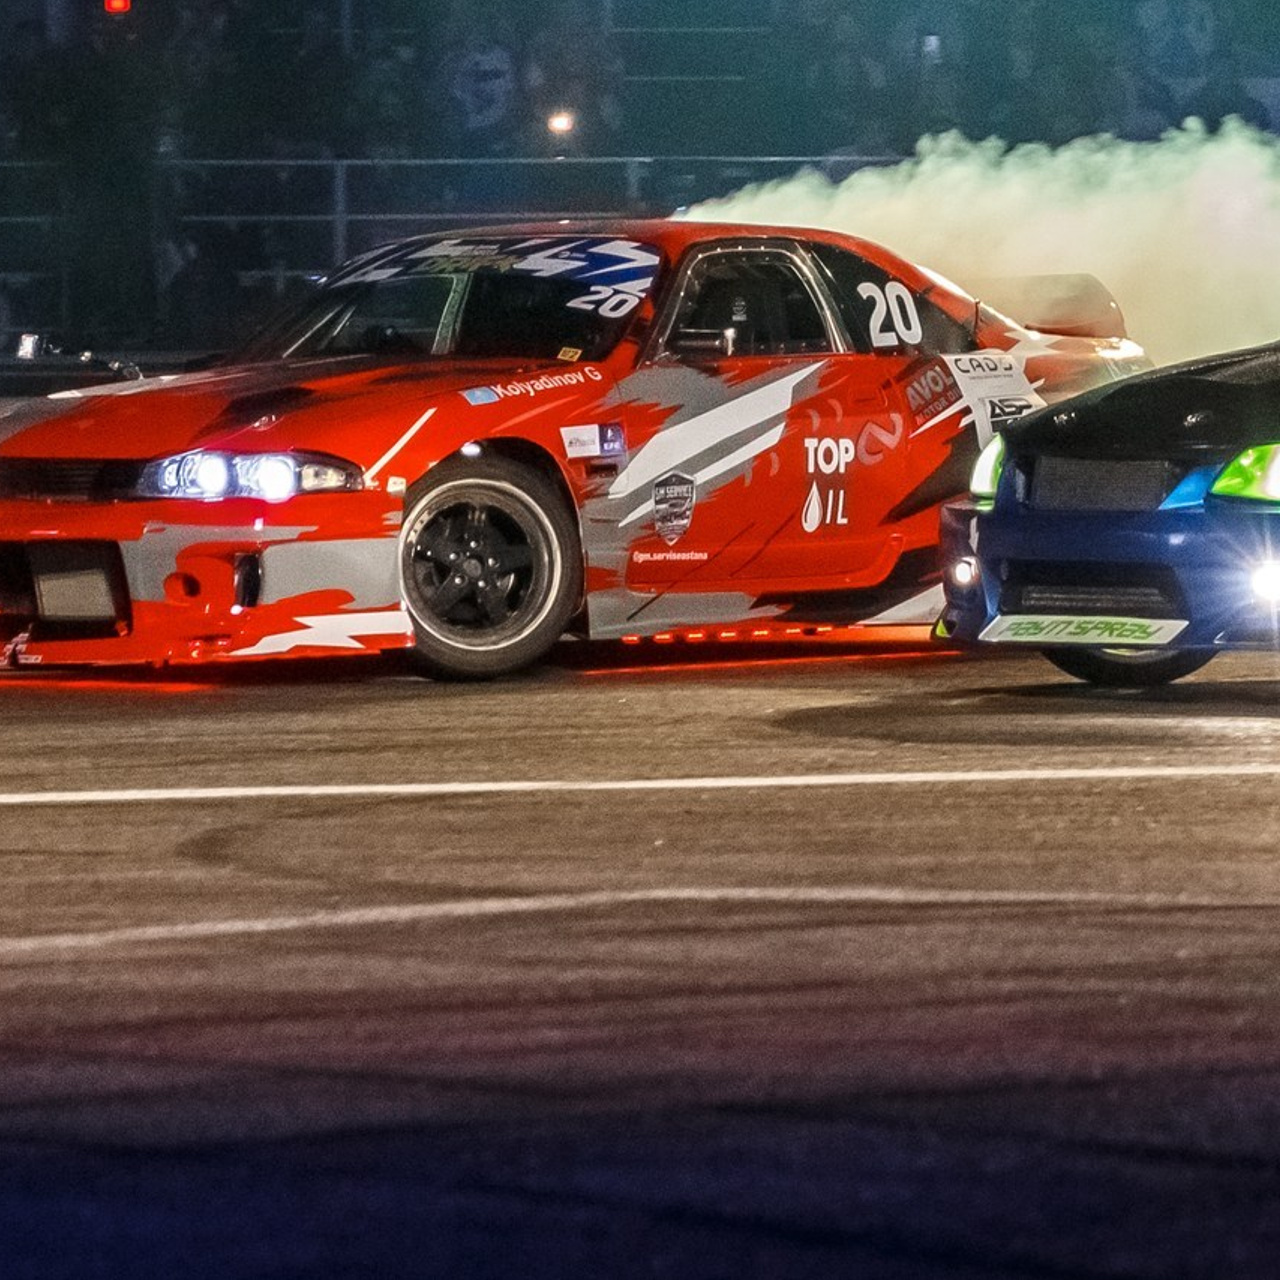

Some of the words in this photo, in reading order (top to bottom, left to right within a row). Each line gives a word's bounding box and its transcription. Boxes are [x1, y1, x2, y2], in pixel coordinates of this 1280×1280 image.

[565, 285, 641, 319] 20
[857, 280, 923, 348] 20
[490, 370, 585, 397] Kolyadinov
[583, 366, 602, 381] G
[804, 437, 855, 474] TOP
